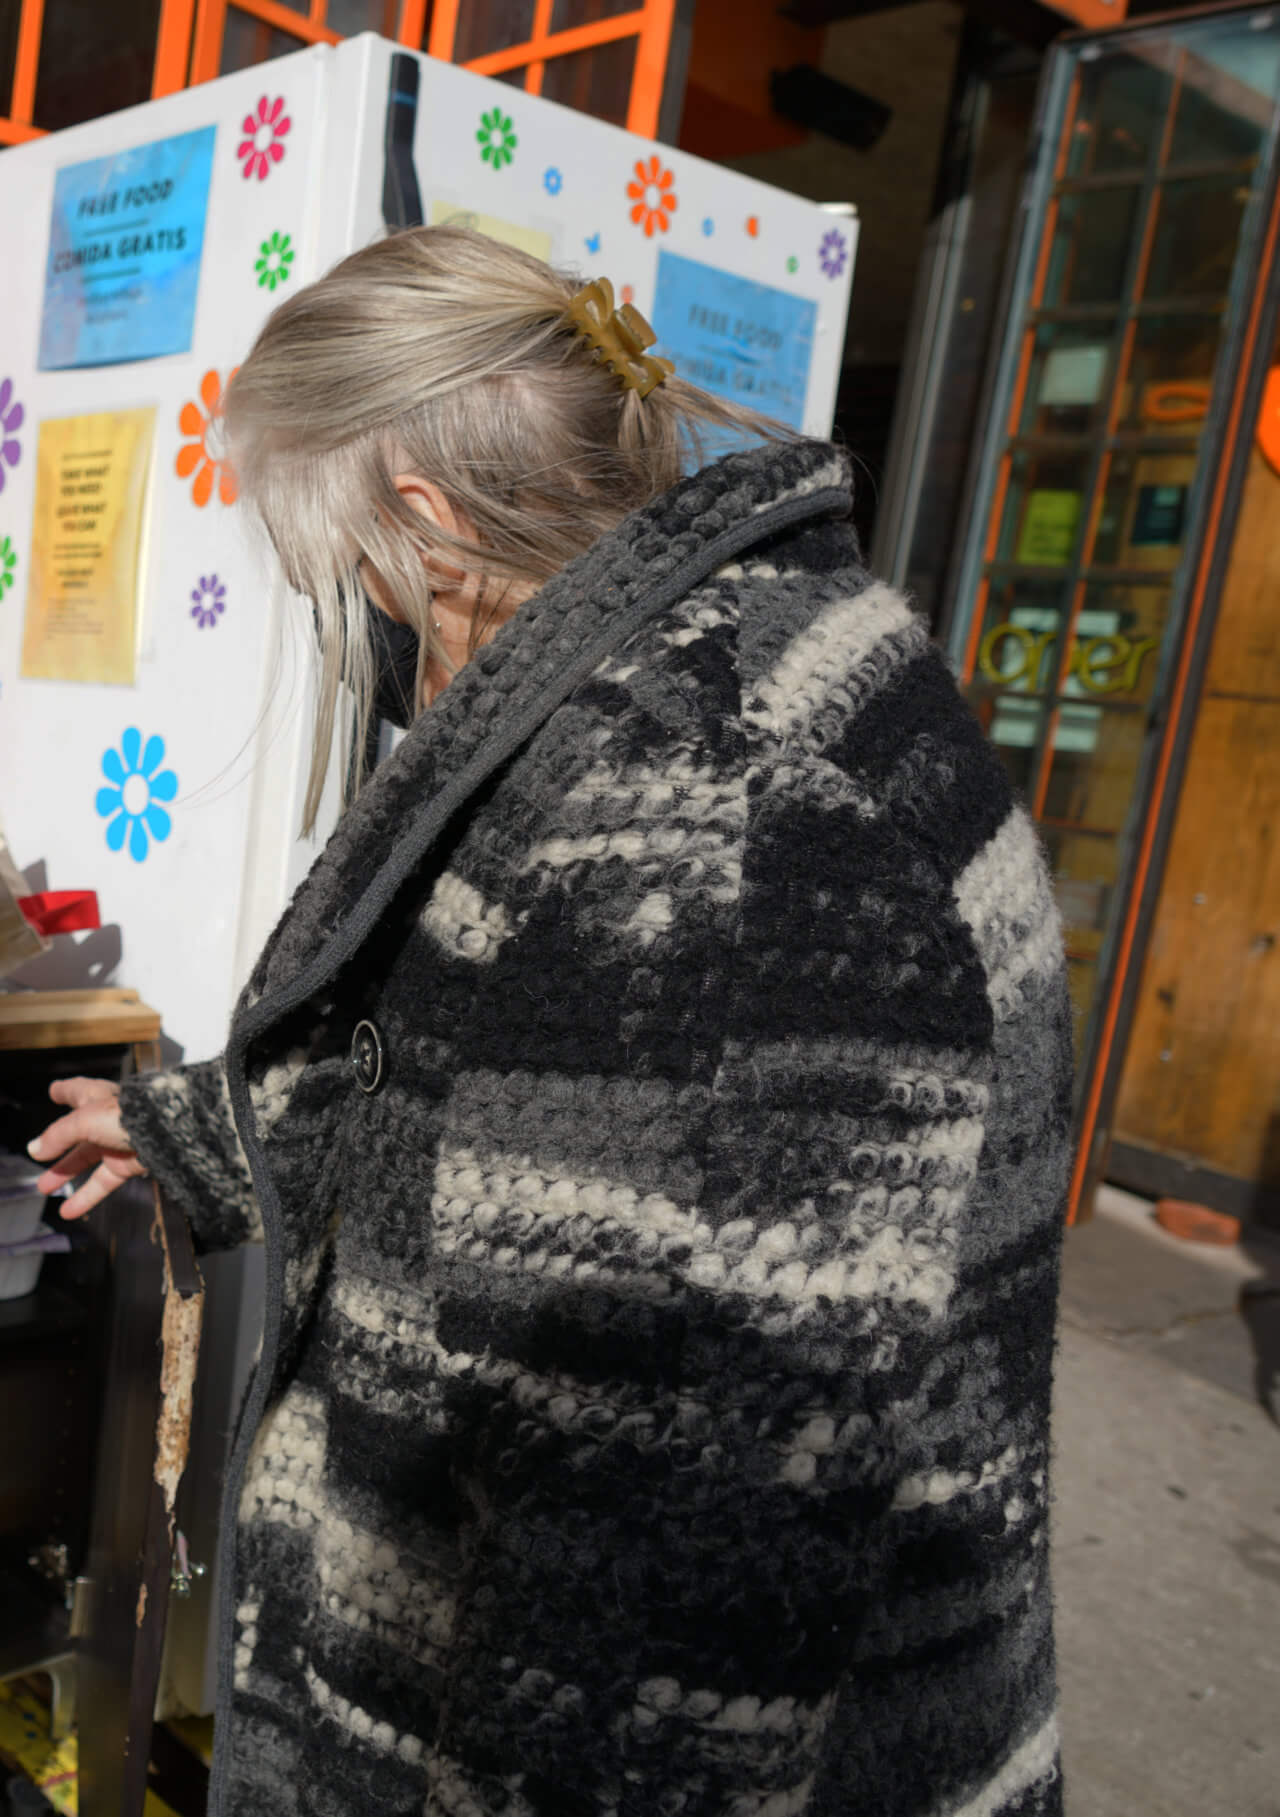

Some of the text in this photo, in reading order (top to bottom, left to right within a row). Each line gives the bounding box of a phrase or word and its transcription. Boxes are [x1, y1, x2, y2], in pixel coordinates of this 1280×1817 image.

[77, 178, 175, 218] FREE FOOD
[53, 226, 188, 274] COMIDA GRATIS
